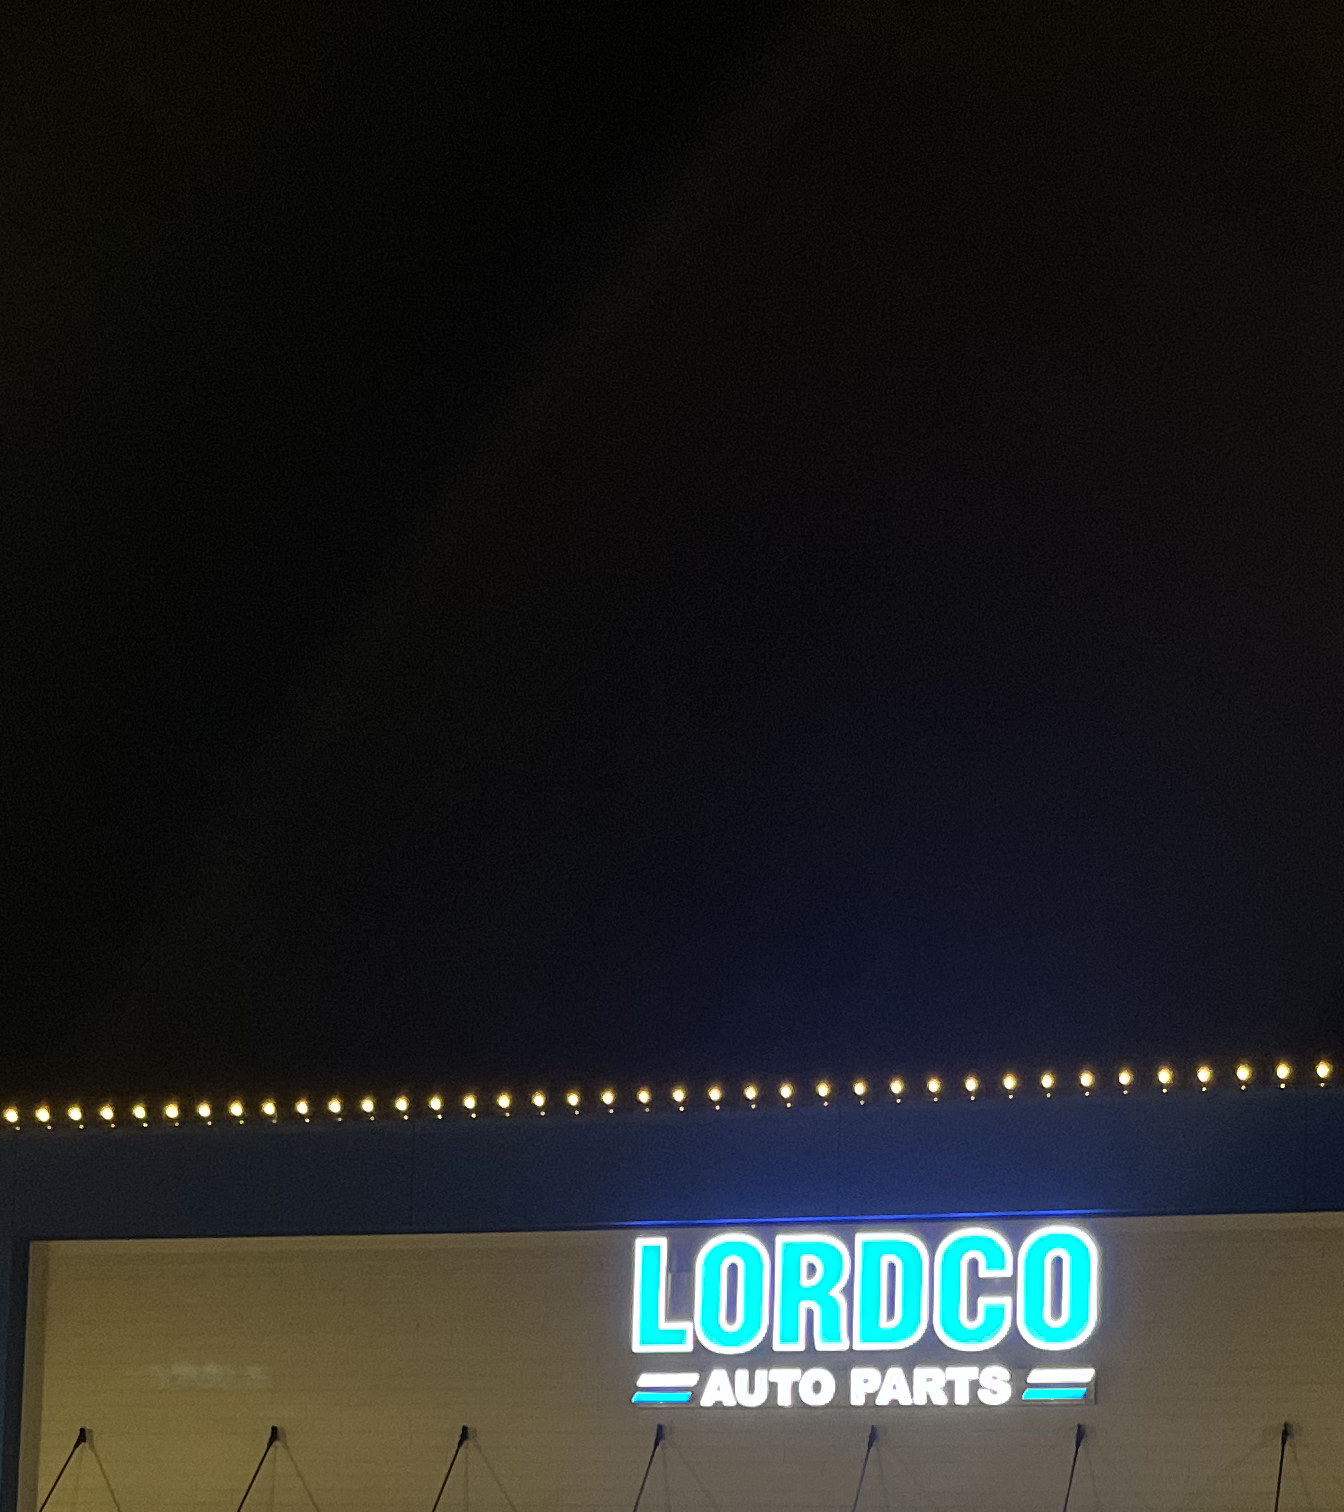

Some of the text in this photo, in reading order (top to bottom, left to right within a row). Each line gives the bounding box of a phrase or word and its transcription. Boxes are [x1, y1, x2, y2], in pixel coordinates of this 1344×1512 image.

[632, 1225, 1098, 1354] LORDCO
[700, 1365, 1012, 1407] AUTO PARTS
